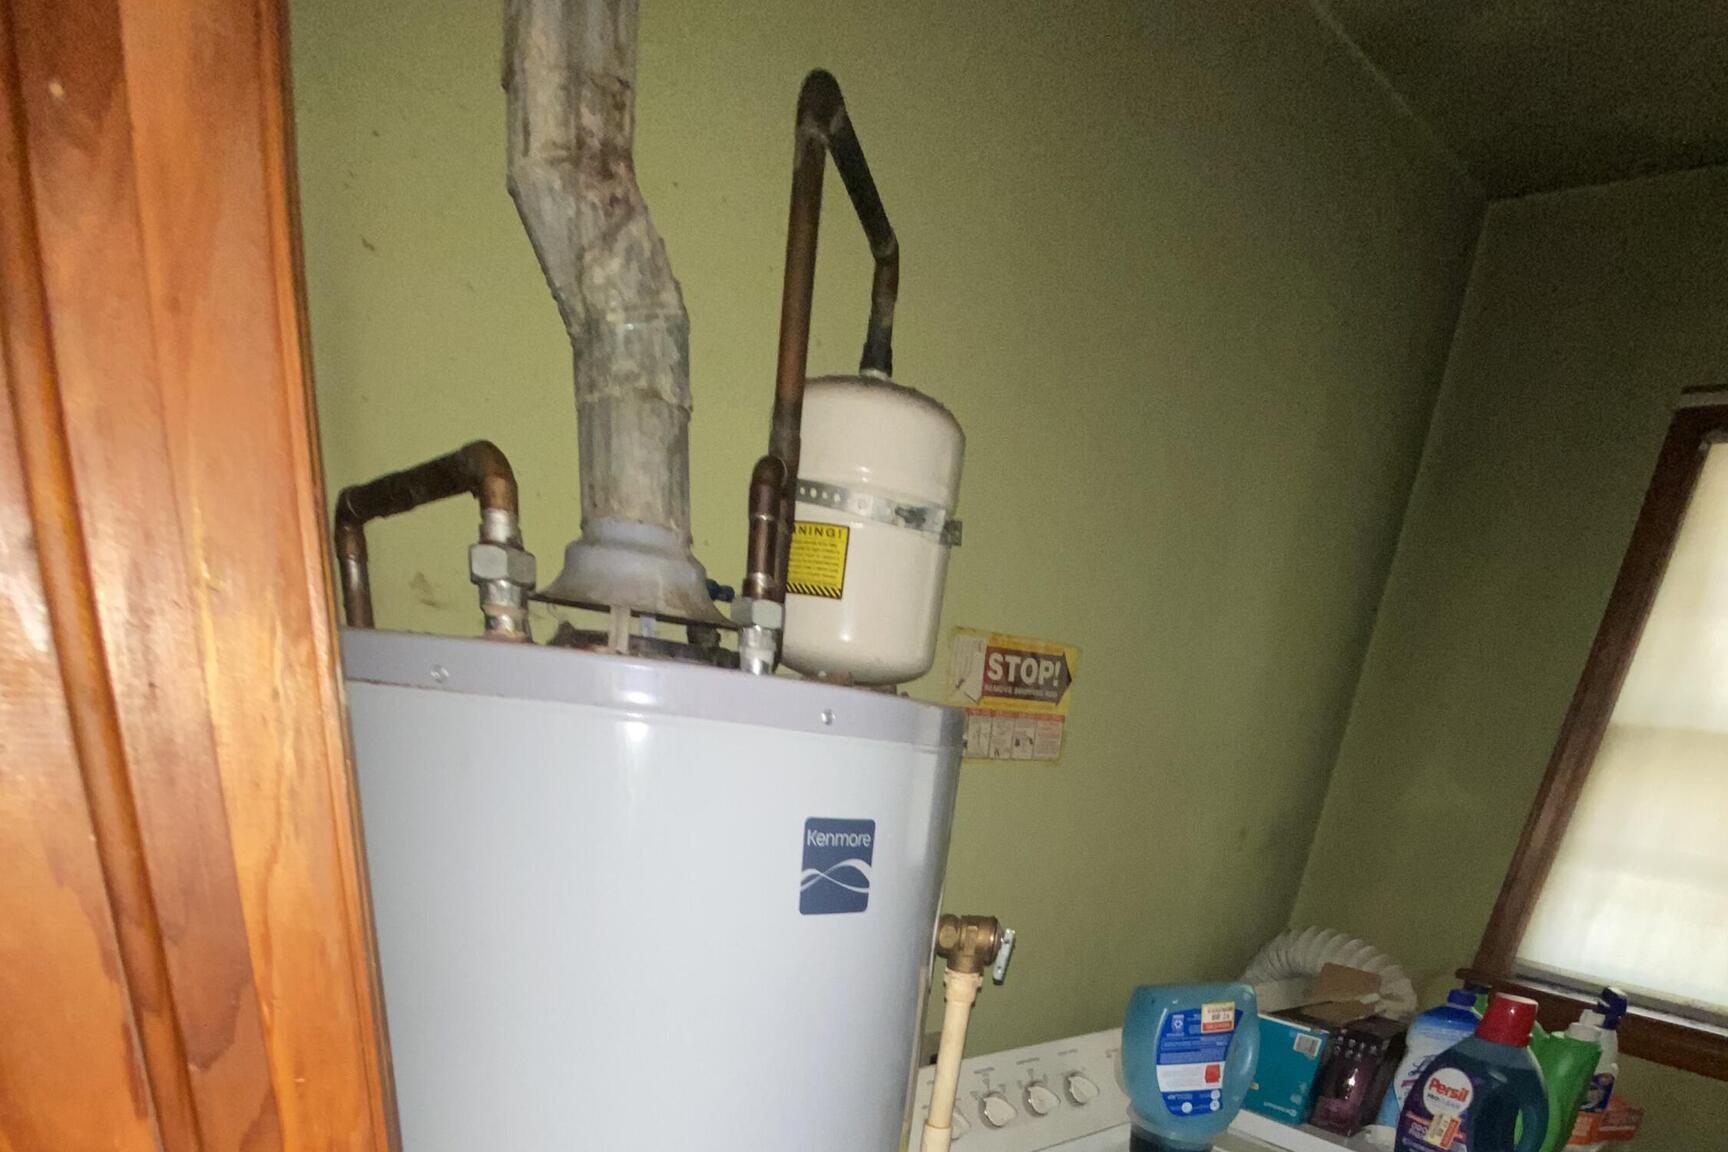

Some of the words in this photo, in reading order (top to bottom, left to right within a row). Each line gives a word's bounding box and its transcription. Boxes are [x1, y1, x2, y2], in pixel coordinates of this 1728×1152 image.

[794, 523, 842, 539] NING!
[987, 651, 1062, 687] STOP!
[807, 828, 872, 848] Kenmore
[1428, 1077, 1470, 1103] Persil
